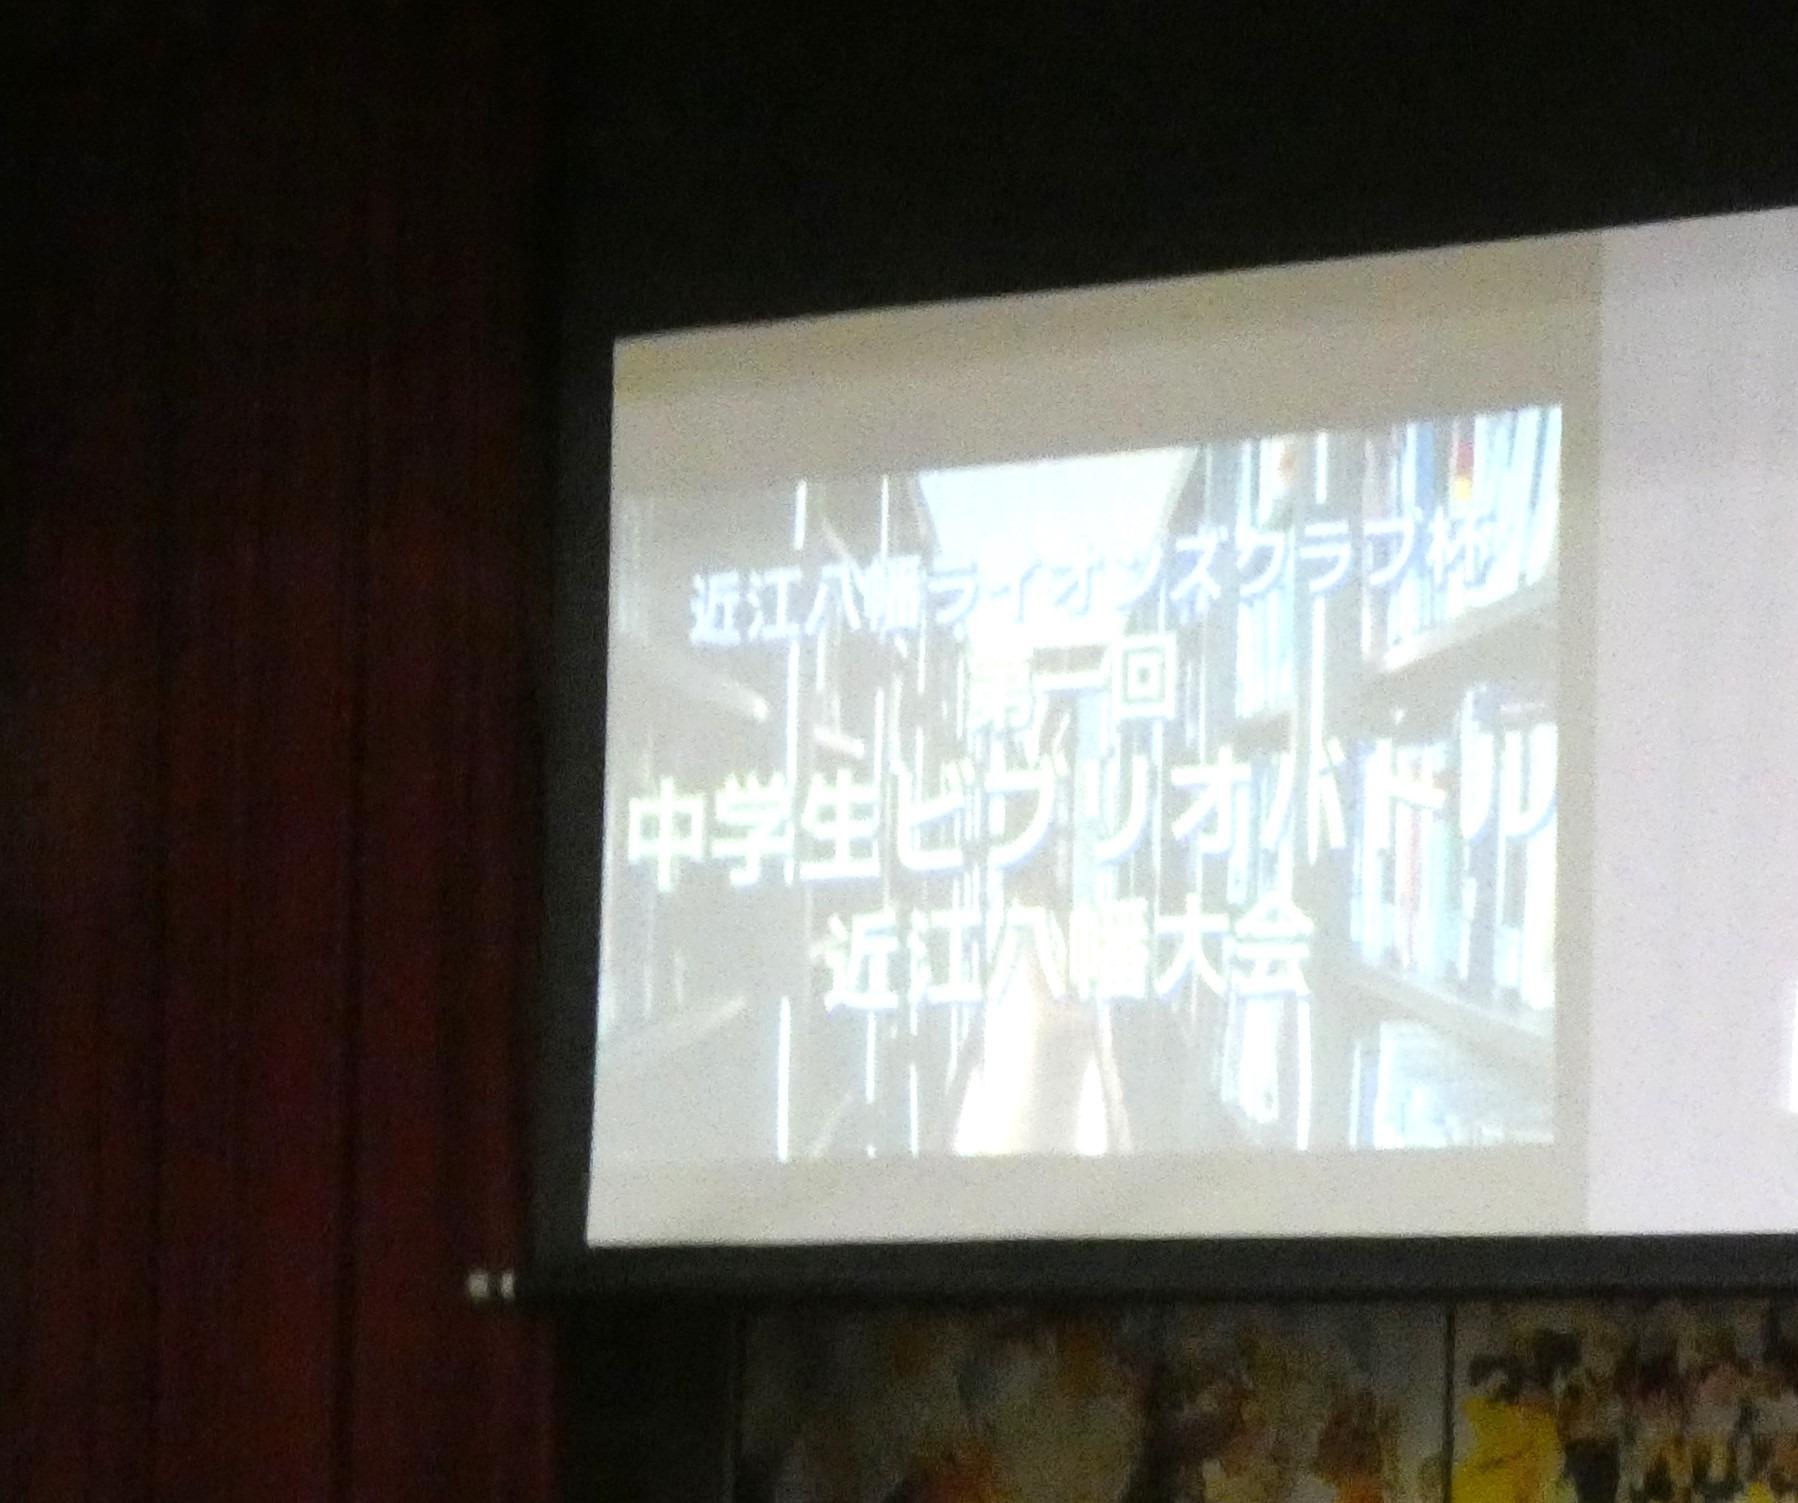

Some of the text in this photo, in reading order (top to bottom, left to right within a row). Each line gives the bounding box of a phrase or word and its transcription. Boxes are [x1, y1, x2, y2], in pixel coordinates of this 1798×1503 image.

[628, 732, 1558, 893] 中学生ビブリオバトル
[824, 895, 1316, 1012] 近江八幡大会
